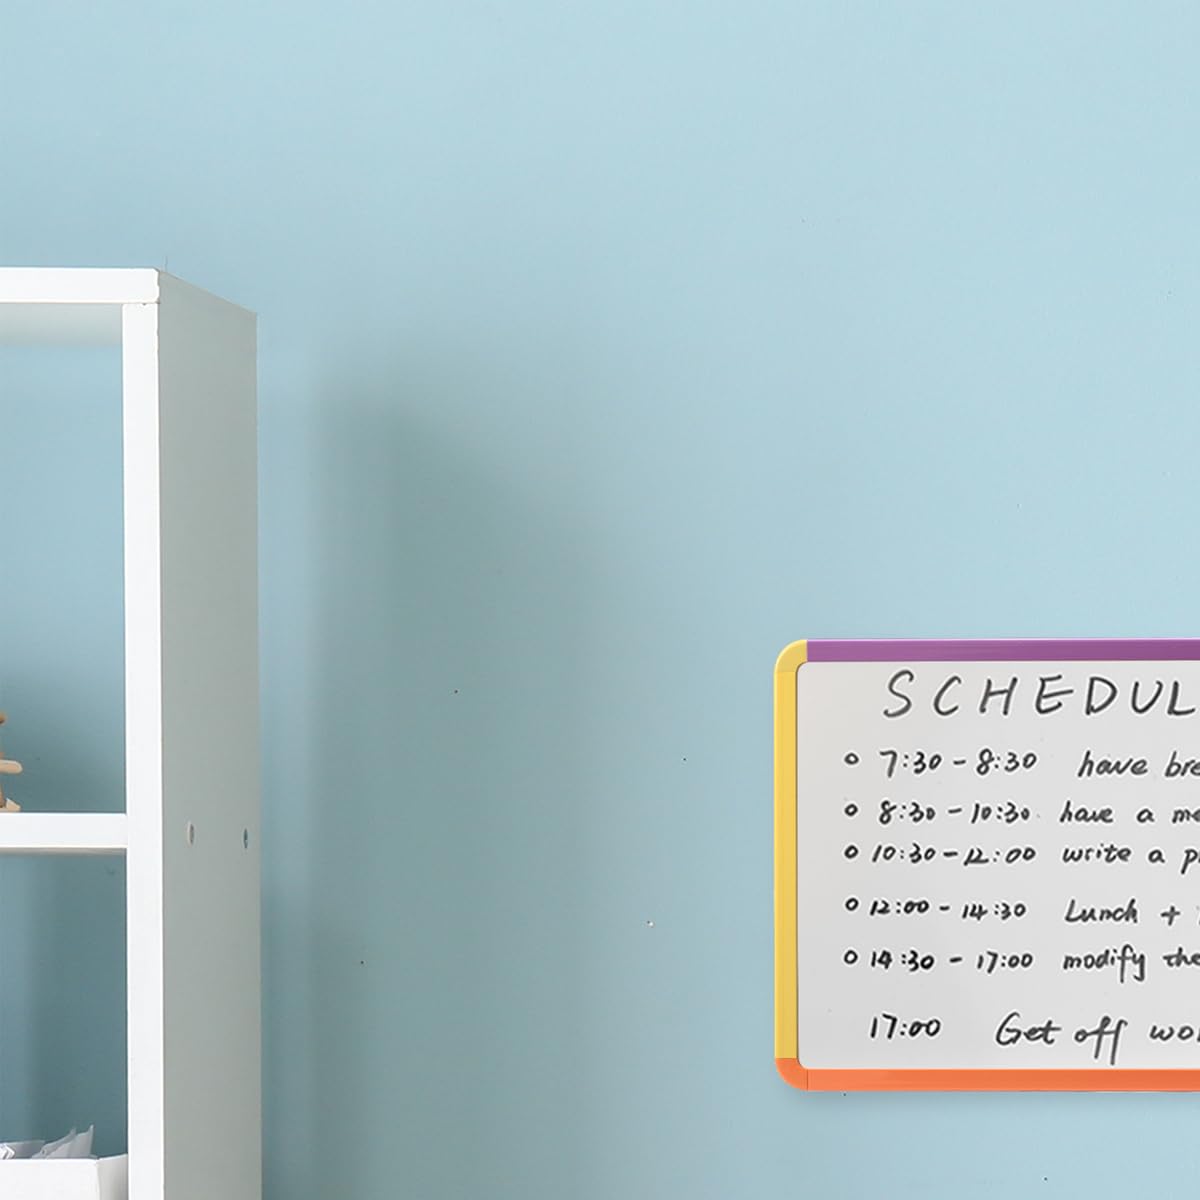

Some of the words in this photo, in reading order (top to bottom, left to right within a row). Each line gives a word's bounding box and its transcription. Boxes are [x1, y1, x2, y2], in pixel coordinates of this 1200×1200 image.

[879, 750, 942, 778] 7:30
[976, 748, 1037, 776] 8:30
[1077, 751, 1148, 778] have
[879, 800, 936, 825] 8:30
[971, 801, 1030, 824] 10:30
[1059, 800, 1114, 824] have
[1136, 808, 1155, 824] a
[1062, 843, 1132, 864] write
[1148, 849, 1166, 864] a
[870, 899, 930, 917] 12:00
[961, 903, 1027, 920] 14:30
[1064, 898, 1138, 924] Lunch
[1160, 905, 1181, 926] +
[870, 949, 935, 972] 14:30
[977, 950, 1033, 974] 17:00
[1062, 943, 1146, 984] modify
[870, 1013, 941, 1040] 17:00
[995, 1011, 1062, 1046] Get
[1074, 1015, 1129, 1066] off
